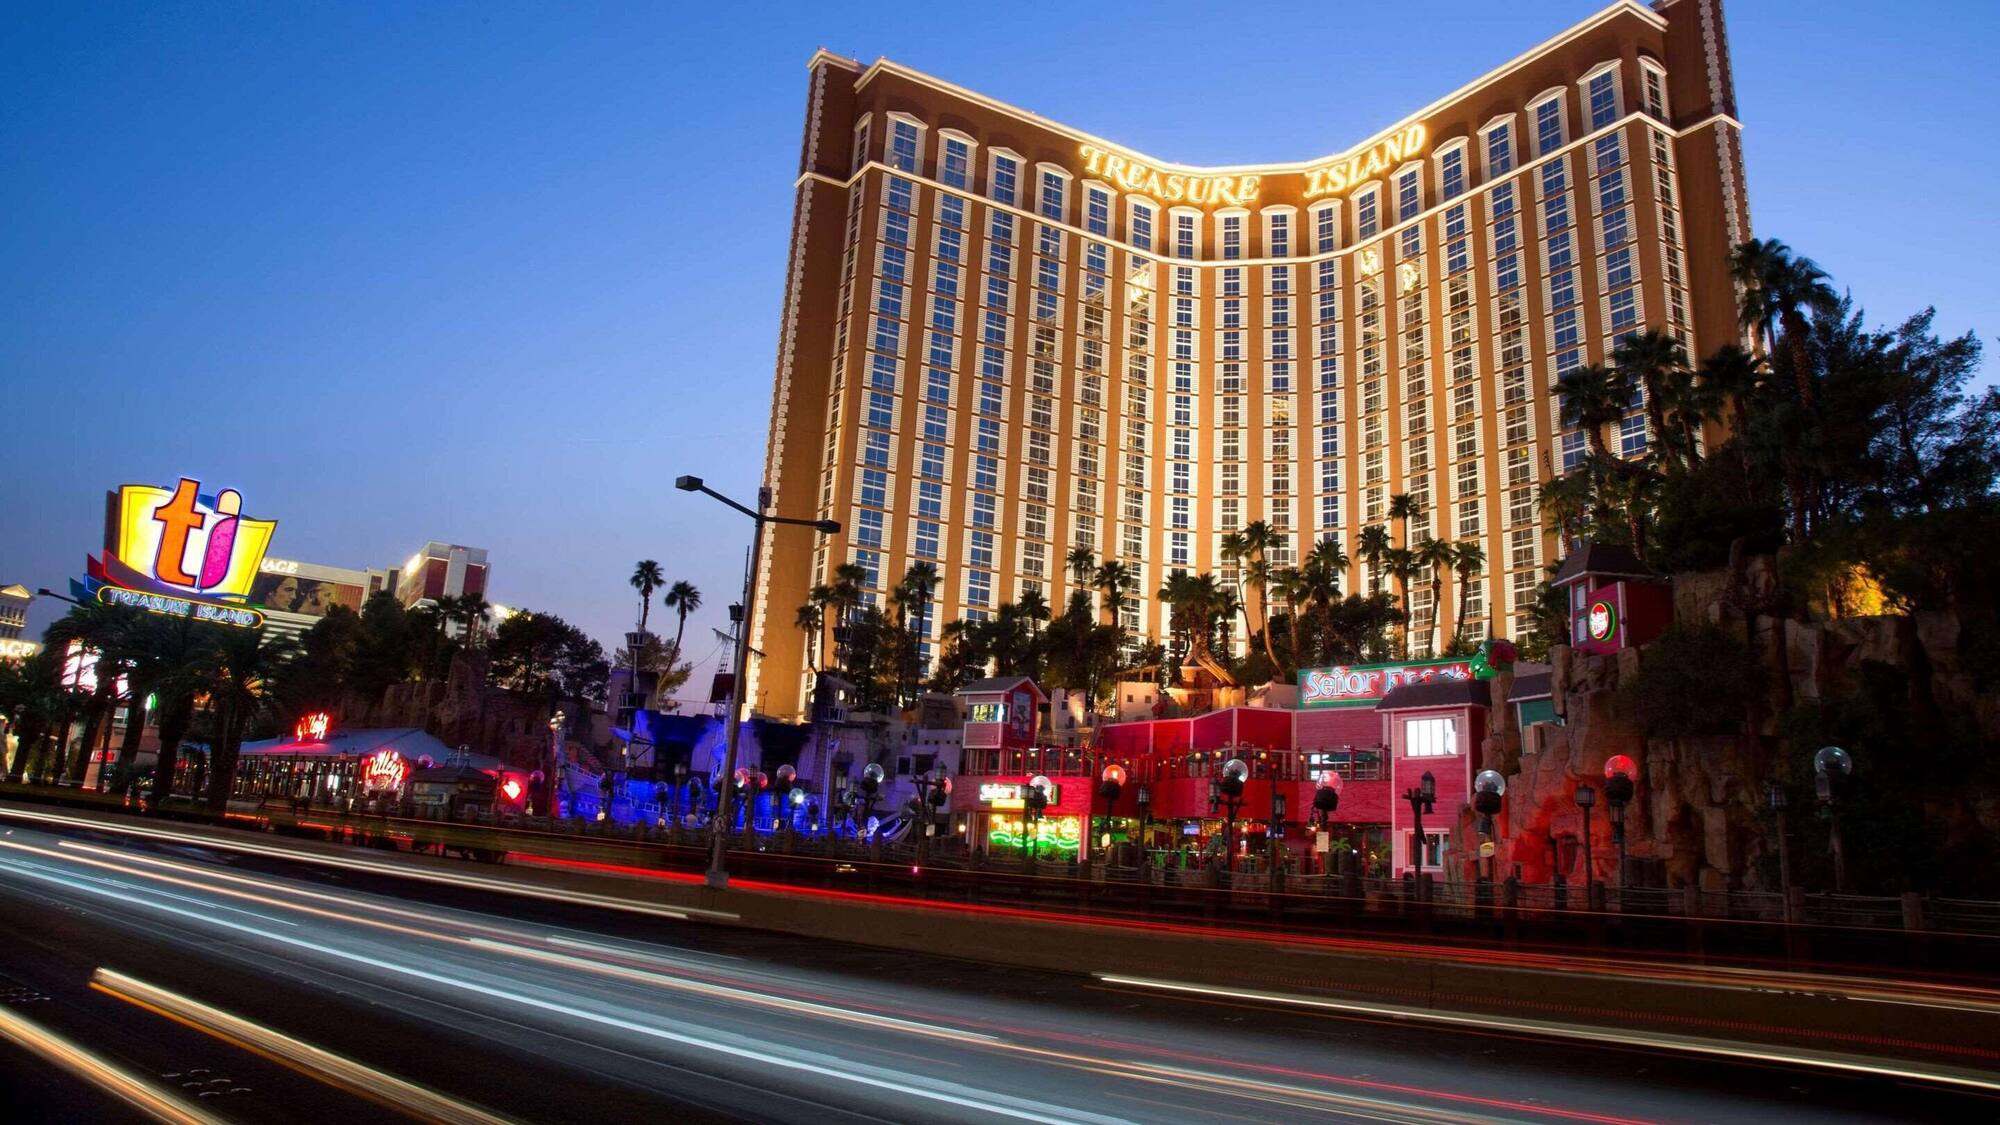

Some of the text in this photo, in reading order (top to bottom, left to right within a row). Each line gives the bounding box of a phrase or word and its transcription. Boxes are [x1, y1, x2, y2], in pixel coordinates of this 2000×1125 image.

[1079, 123, 1426, 207] TREASURE ISLAND
[153, 477, 243, 590] ti
[197, 605, 253, 626] ISLAND
[1304, 664, 1379, 703] Señor
